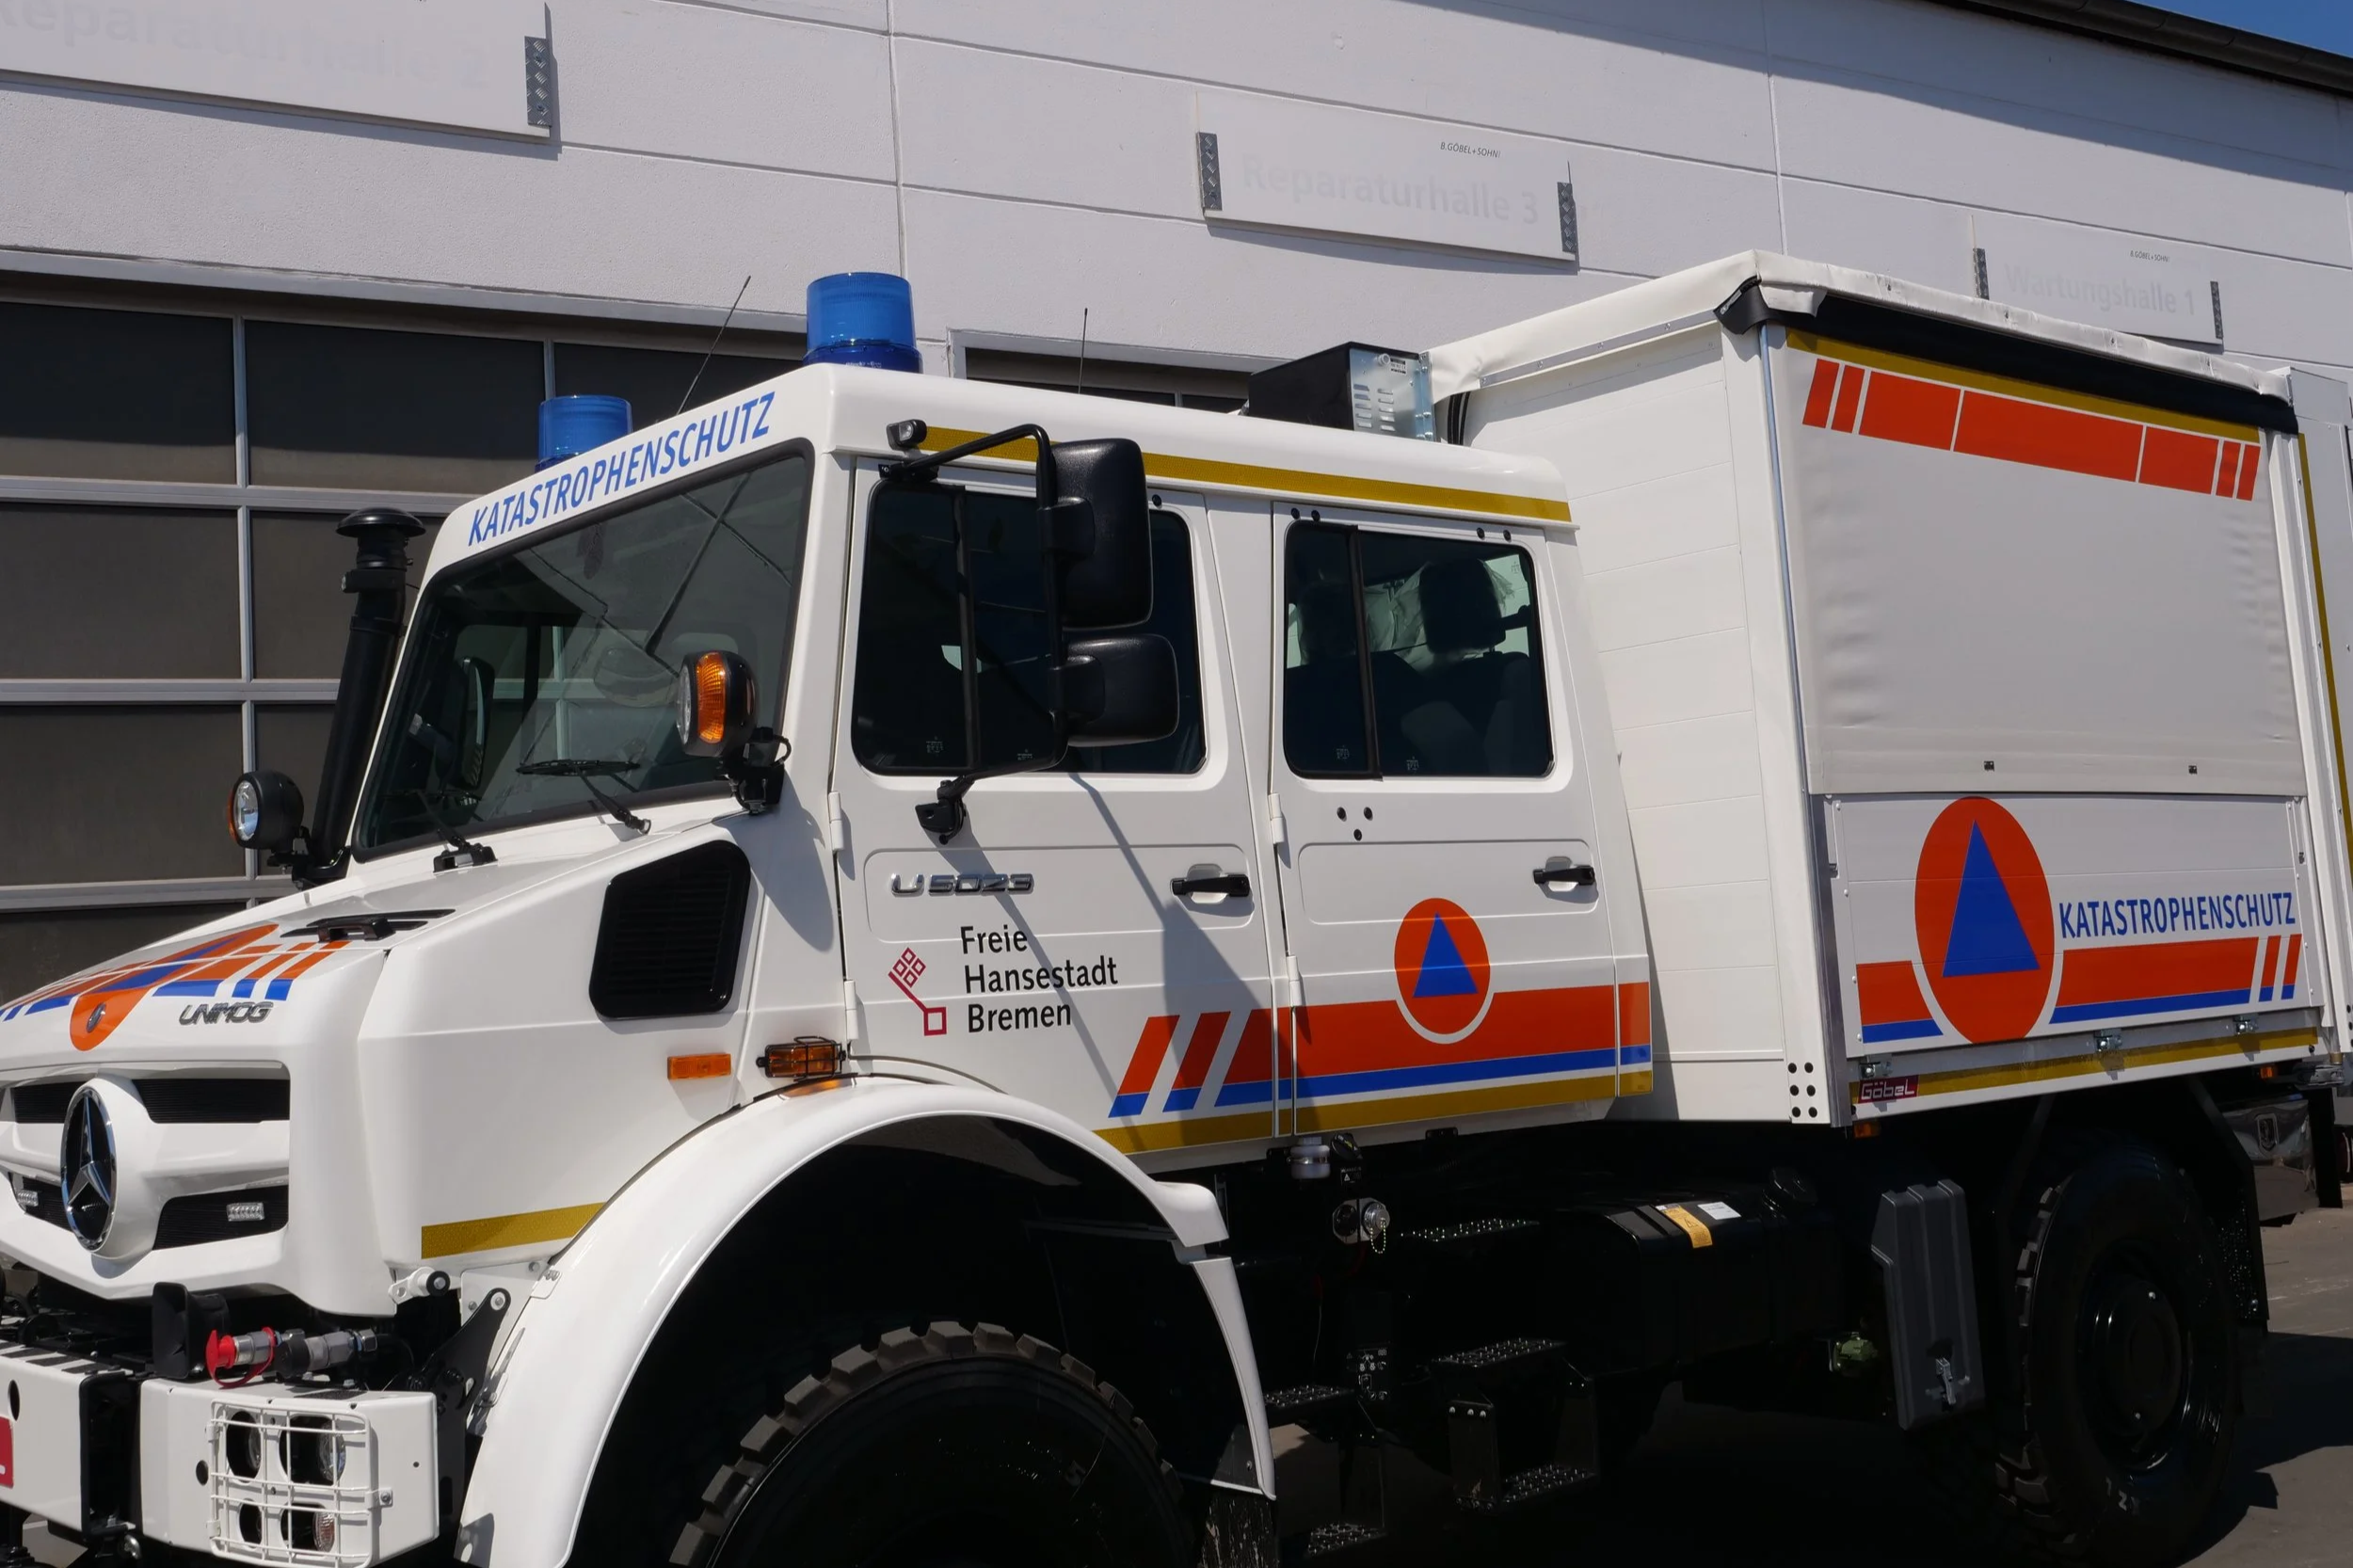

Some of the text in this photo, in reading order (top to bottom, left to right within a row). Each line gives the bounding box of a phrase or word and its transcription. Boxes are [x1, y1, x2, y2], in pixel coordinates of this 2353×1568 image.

[1242, 153, 1539, 224] Reparaturhalle 3
[2004, 264, 2195, 315] Wartungshalle 1
[468, 391, 776, 547] KATASTROPHENSCHUTZ
[2058, 892, 2296, 939] KATASTROPHENSCHUTZ
[960, 924, 1028, 954] Freie
[965, 955, 1118, 994] Hansestadt
[179, 1001, 274, 1025] UNIMOG
[968, 1003, 1071, 1032] Bremen
